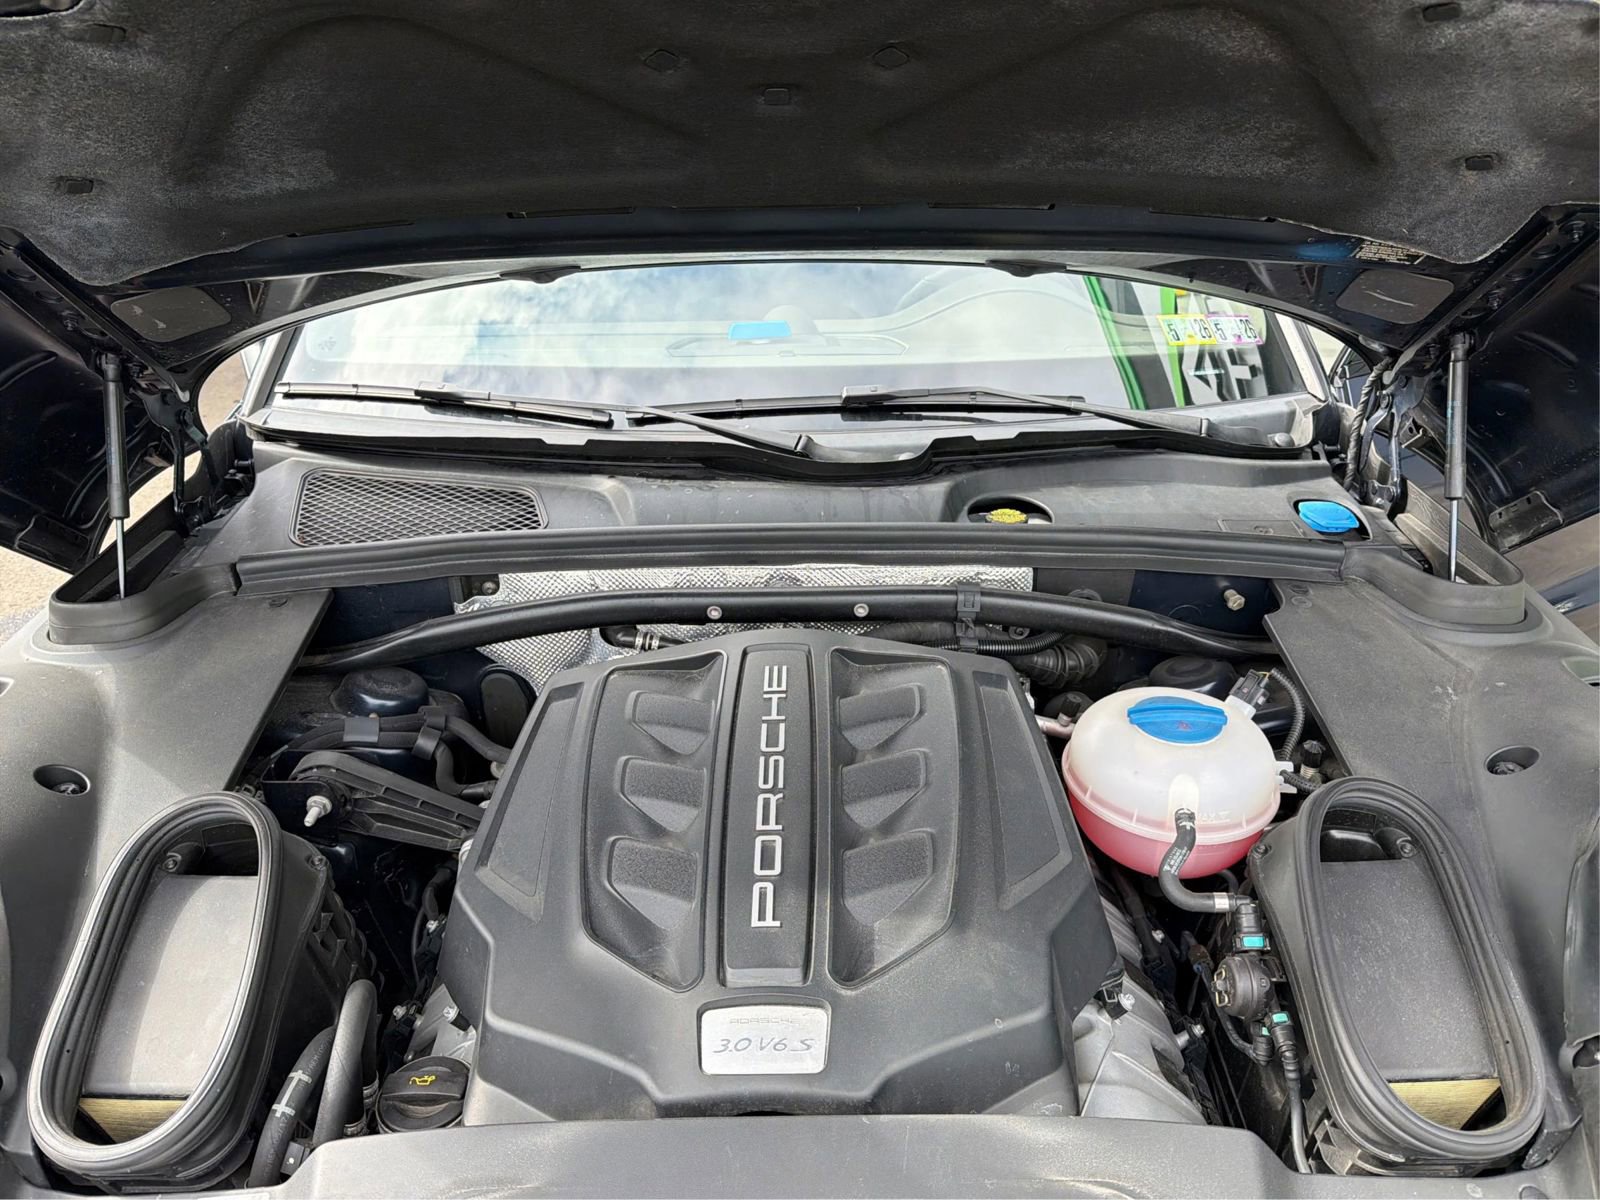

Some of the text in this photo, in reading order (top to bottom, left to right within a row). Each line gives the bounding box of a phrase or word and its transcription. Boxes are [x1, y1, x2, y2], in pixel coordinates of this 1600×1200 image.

[1167, 318, 1213, 341] 5 26
[1214, 318, 1257, 341] 5 26
[750, 664, 788, 929] PORSCHE
[712, 1036, 816, 1054] 3.0 V6 S
